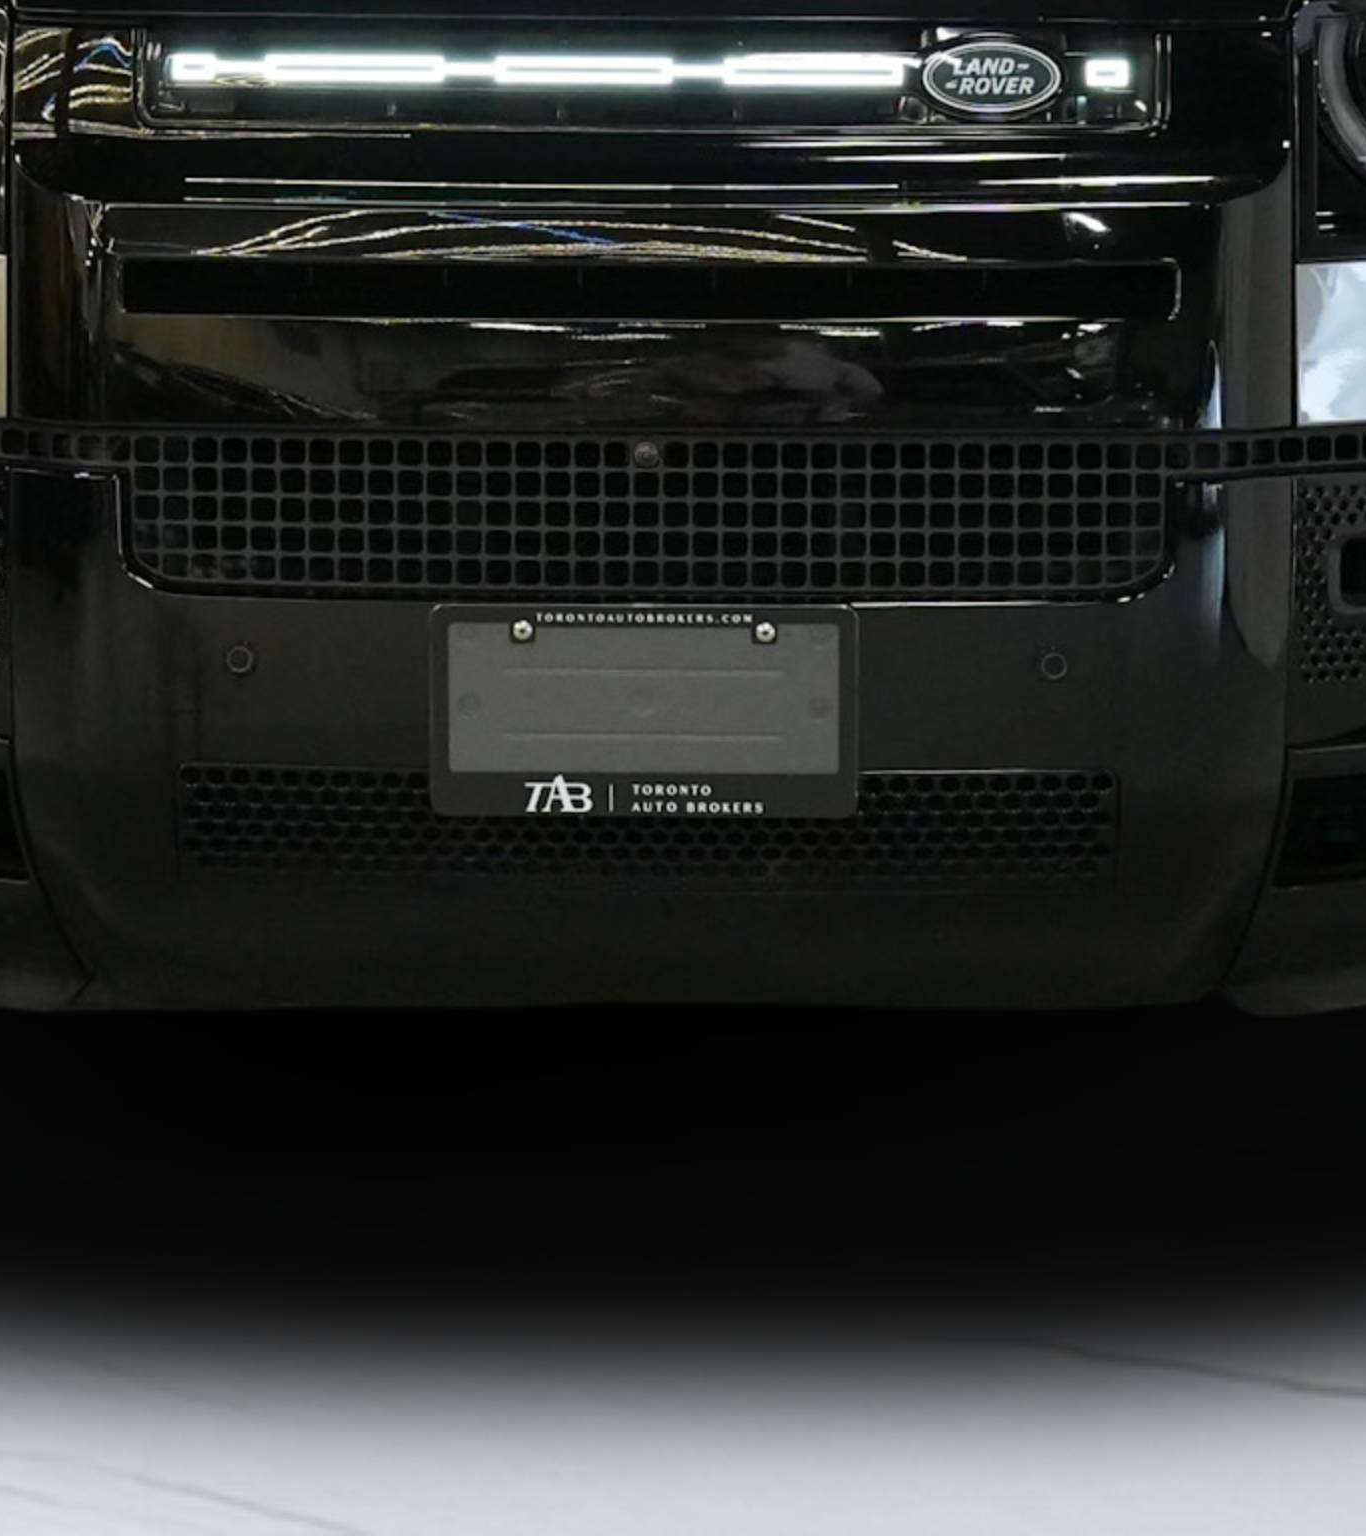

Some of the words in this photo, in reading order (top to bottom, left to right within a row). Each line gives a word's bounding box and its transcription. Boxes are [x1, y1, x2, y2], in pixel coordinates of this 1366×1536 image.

[536, 612, 753, 624] TORONTOAUTOBROKERS.COM
[524, 774, 593, 813] TAB
[632, 783, 712, 796] TORONTO
[631, 801, 678, 813] AUTO
[686, 801, 764, 814] BROKERS
